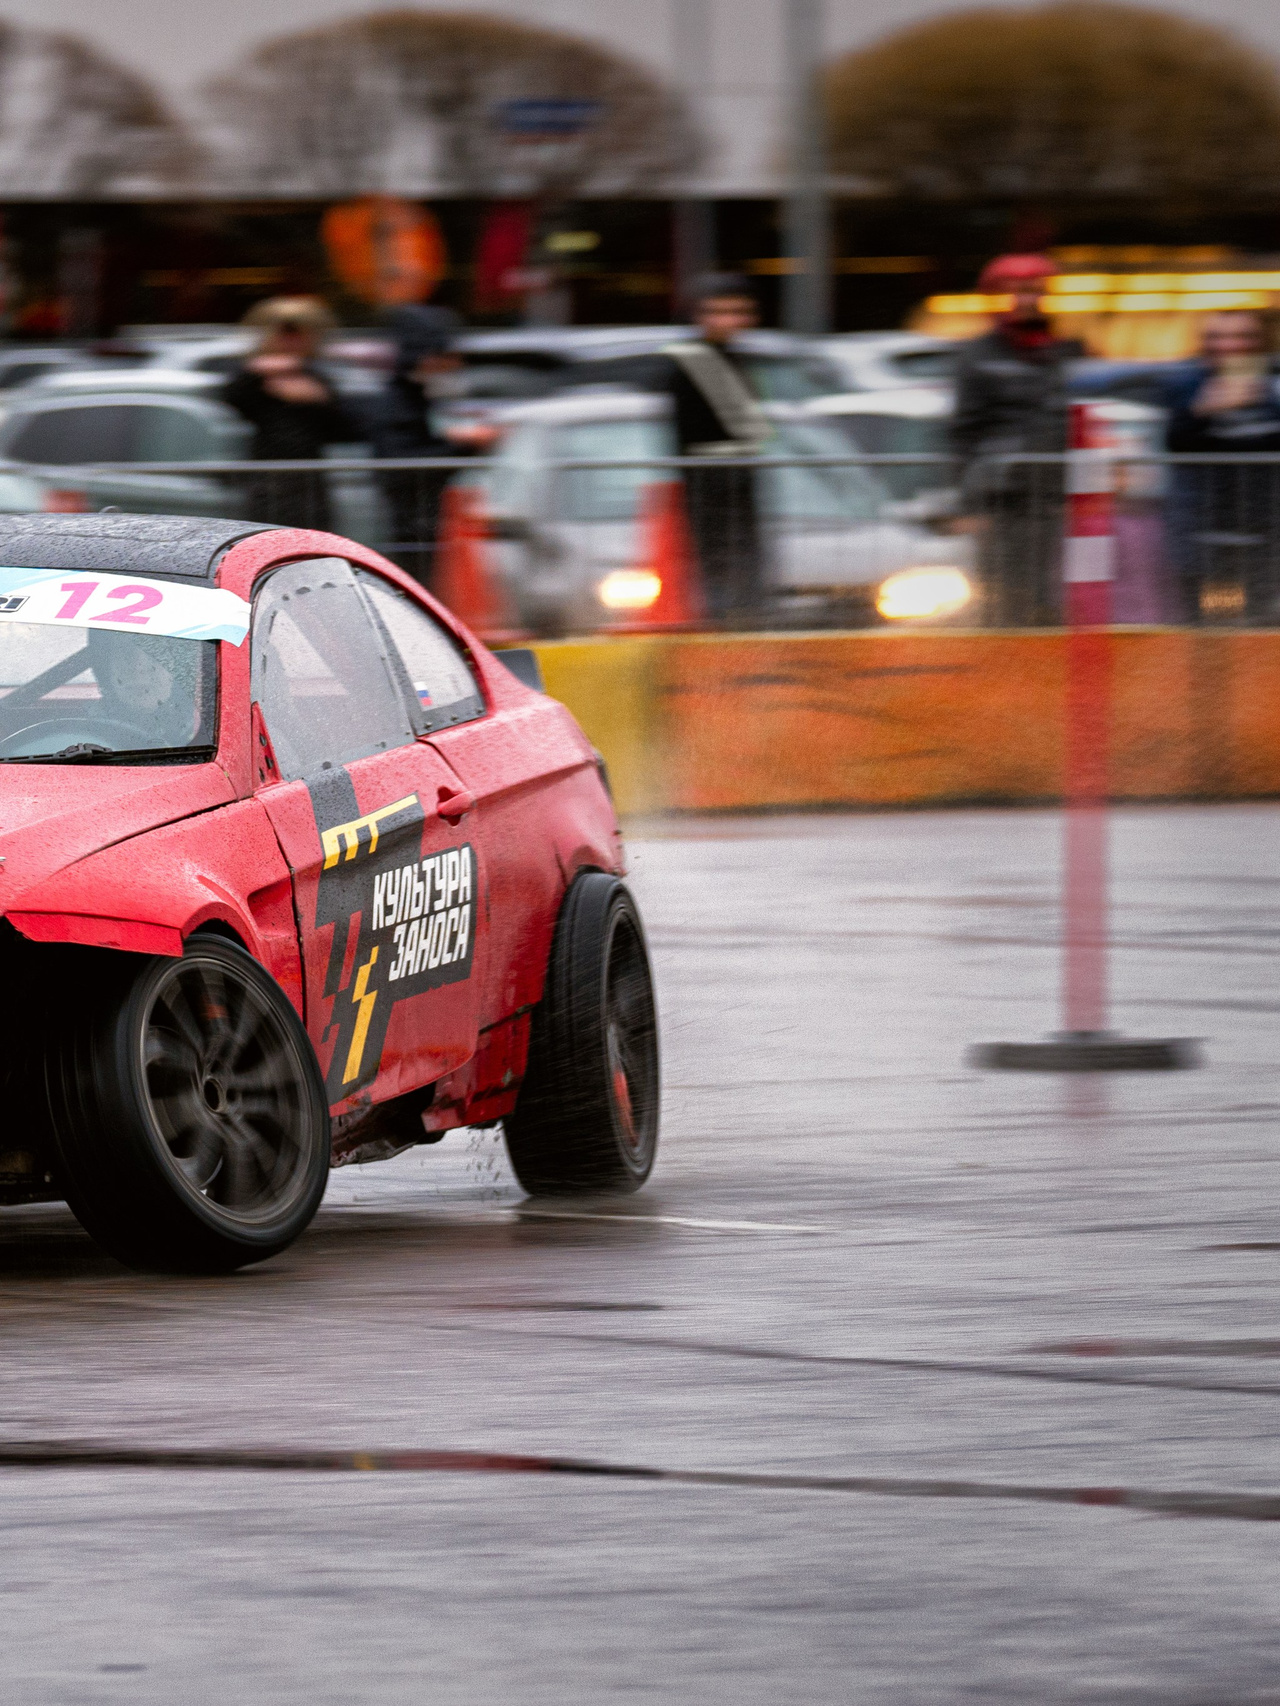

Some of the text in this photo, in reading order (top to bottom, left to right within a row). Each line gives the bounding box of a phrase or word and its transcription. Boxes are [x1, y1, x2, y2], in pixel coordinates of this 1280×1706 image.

[54, 581, 164, 625] 12
[372, 846, 471, 931] КУЛЬТУРА
[388, 903, 471, 982] ЗАНОСА
